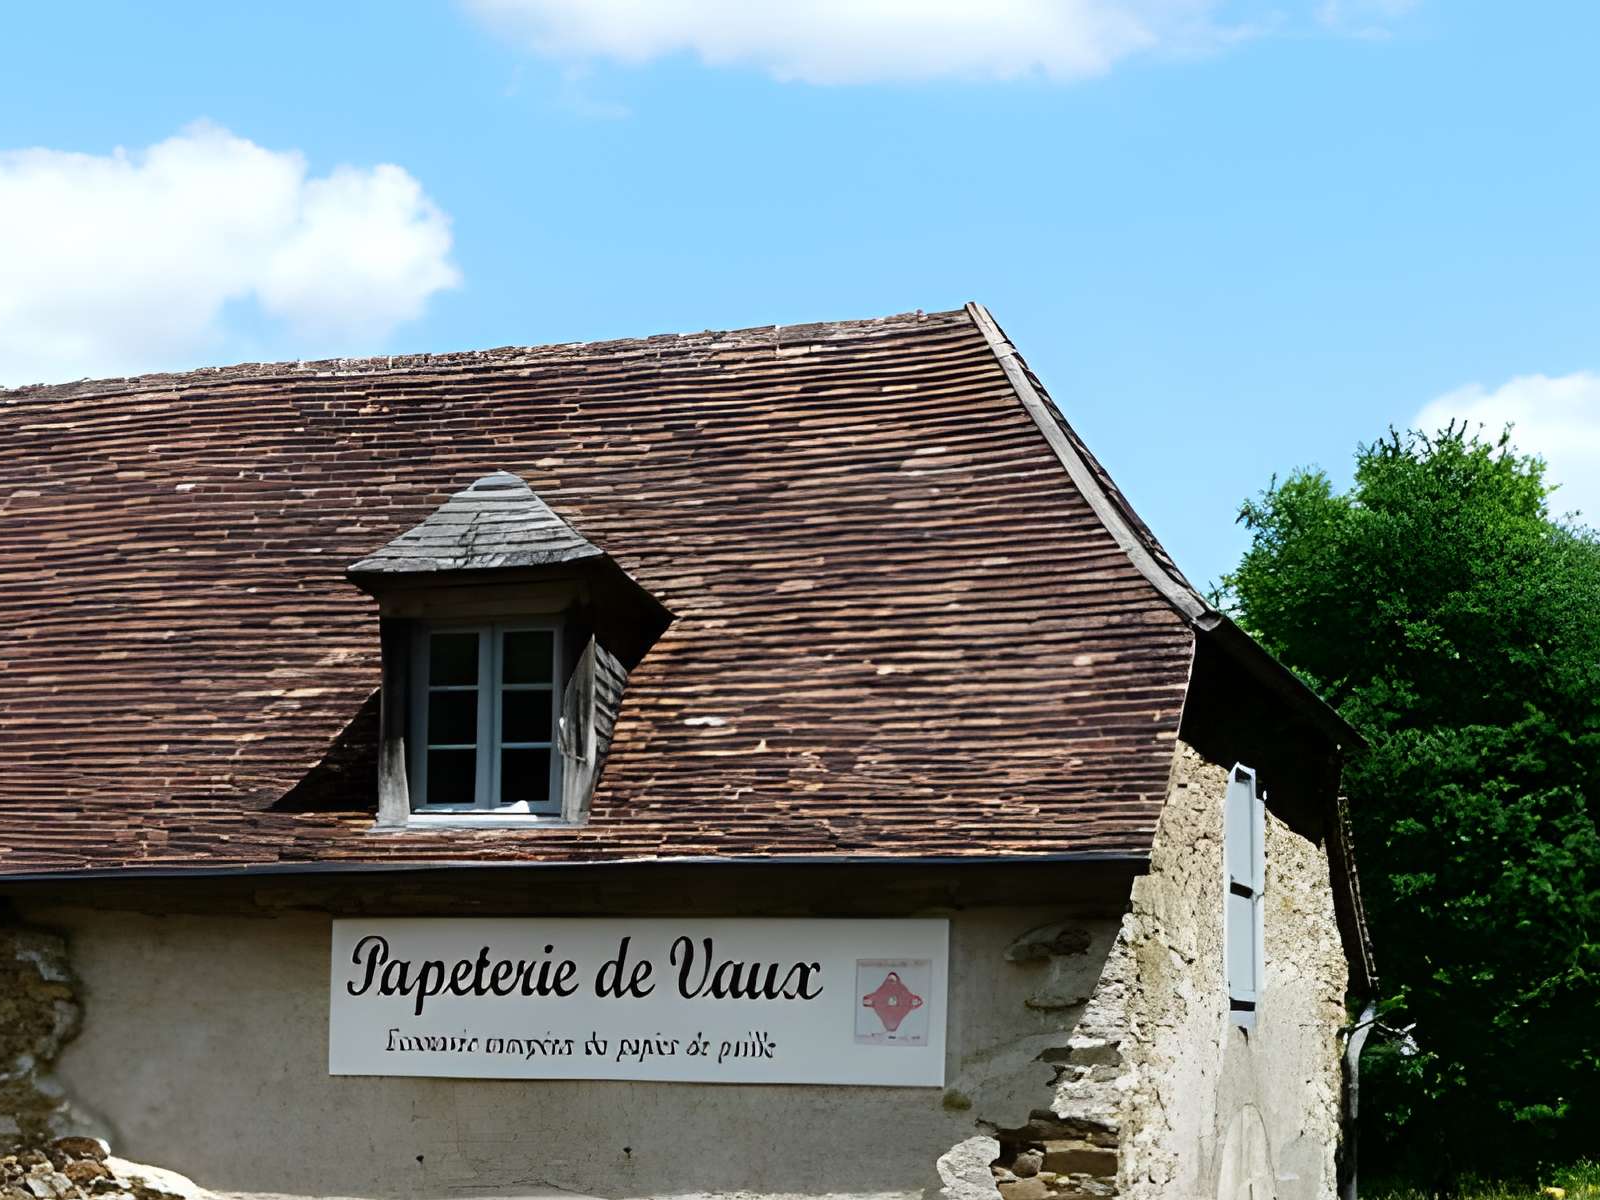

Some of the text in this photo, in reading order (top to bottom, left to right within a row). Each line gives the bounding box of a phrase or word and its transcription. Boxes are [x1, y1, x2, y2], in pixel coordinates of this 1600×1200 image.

[347, 935, 824, 1016] Papeterie de Vaux
